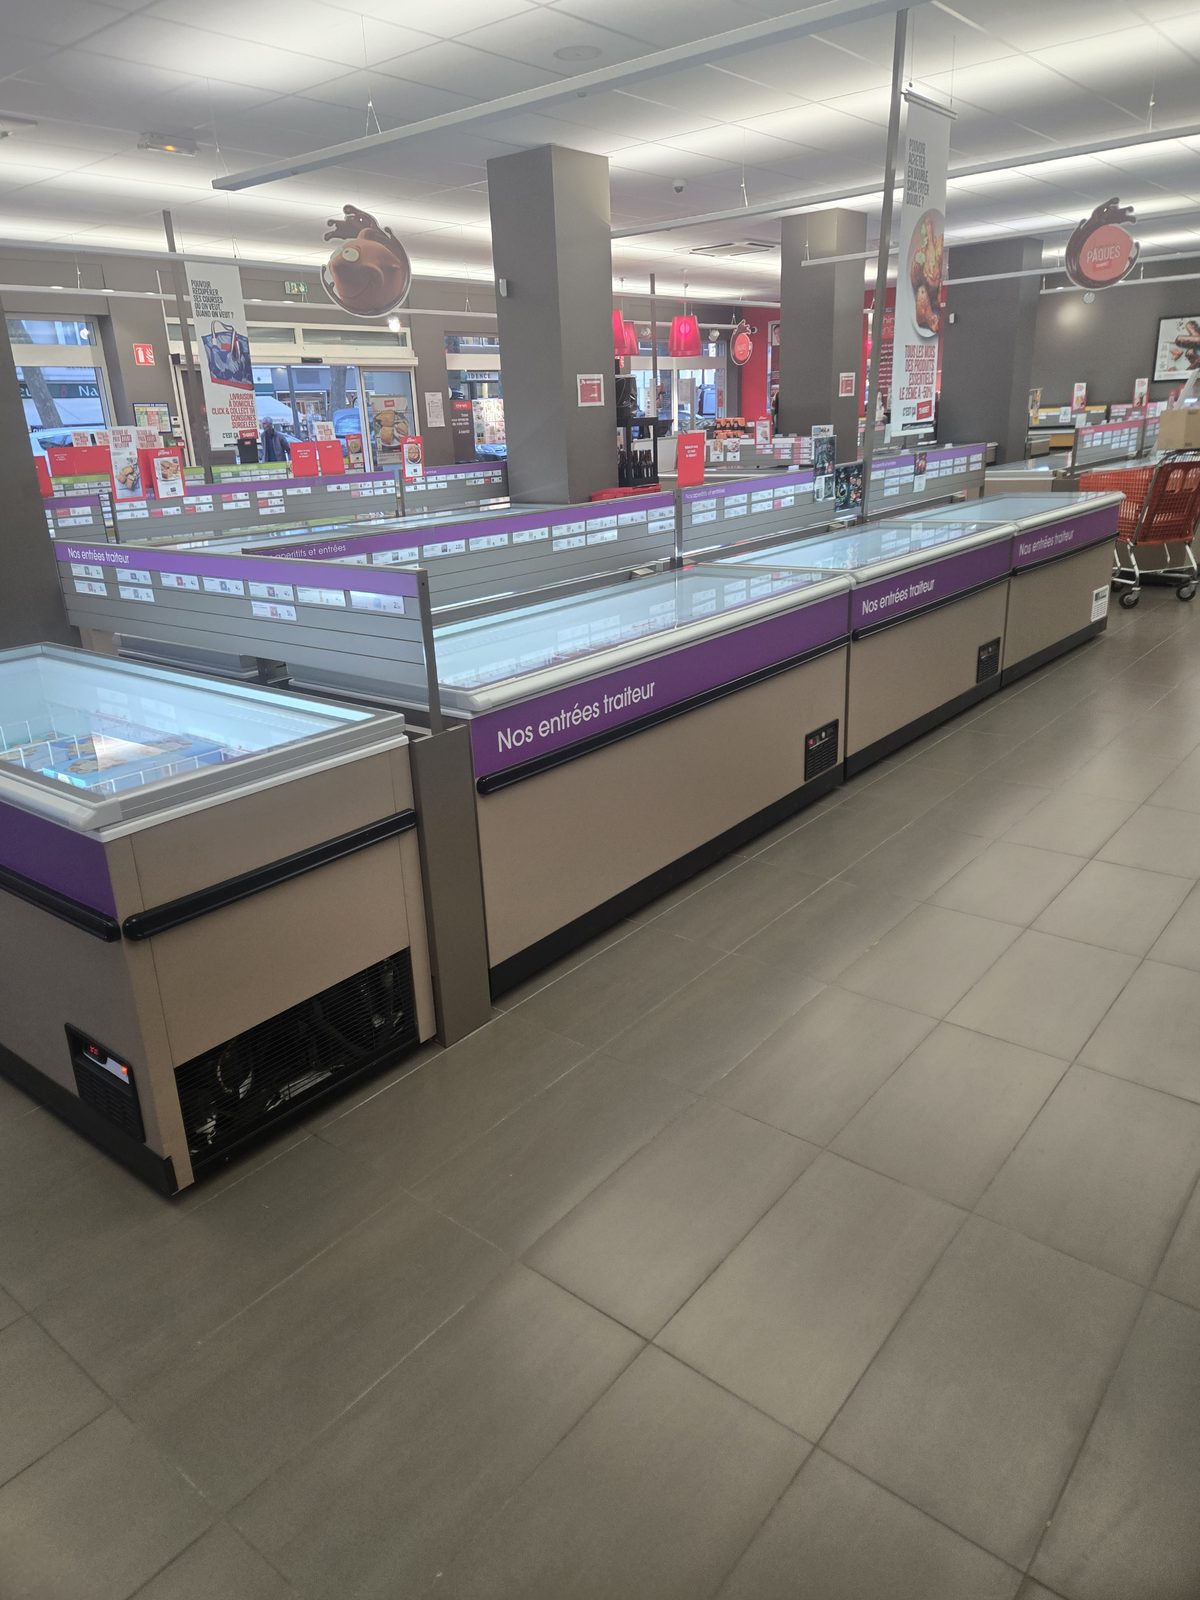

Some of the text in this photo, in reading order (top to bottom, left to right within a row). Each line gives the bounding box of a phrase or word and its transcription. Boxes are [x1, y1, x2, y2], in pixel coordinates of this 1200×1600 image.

[916, 345, 924, 358] LES
[905, 359, 914, 372] DES
[211, 407, 225, 415] CLICK
[229, 407, 249, 415] COLLECT
[308, 548, 316, 556] et
[318, 544, 347, 555] entrées
[1019, 529, 1075, 557] Nos entrées traiteur
[67, 547, 129, 564] Nos entrées traiteur
[862, 579, 936, 616] Nos entrées traiteur
[497, 681, 656, 752] Nos entrées traiteur
